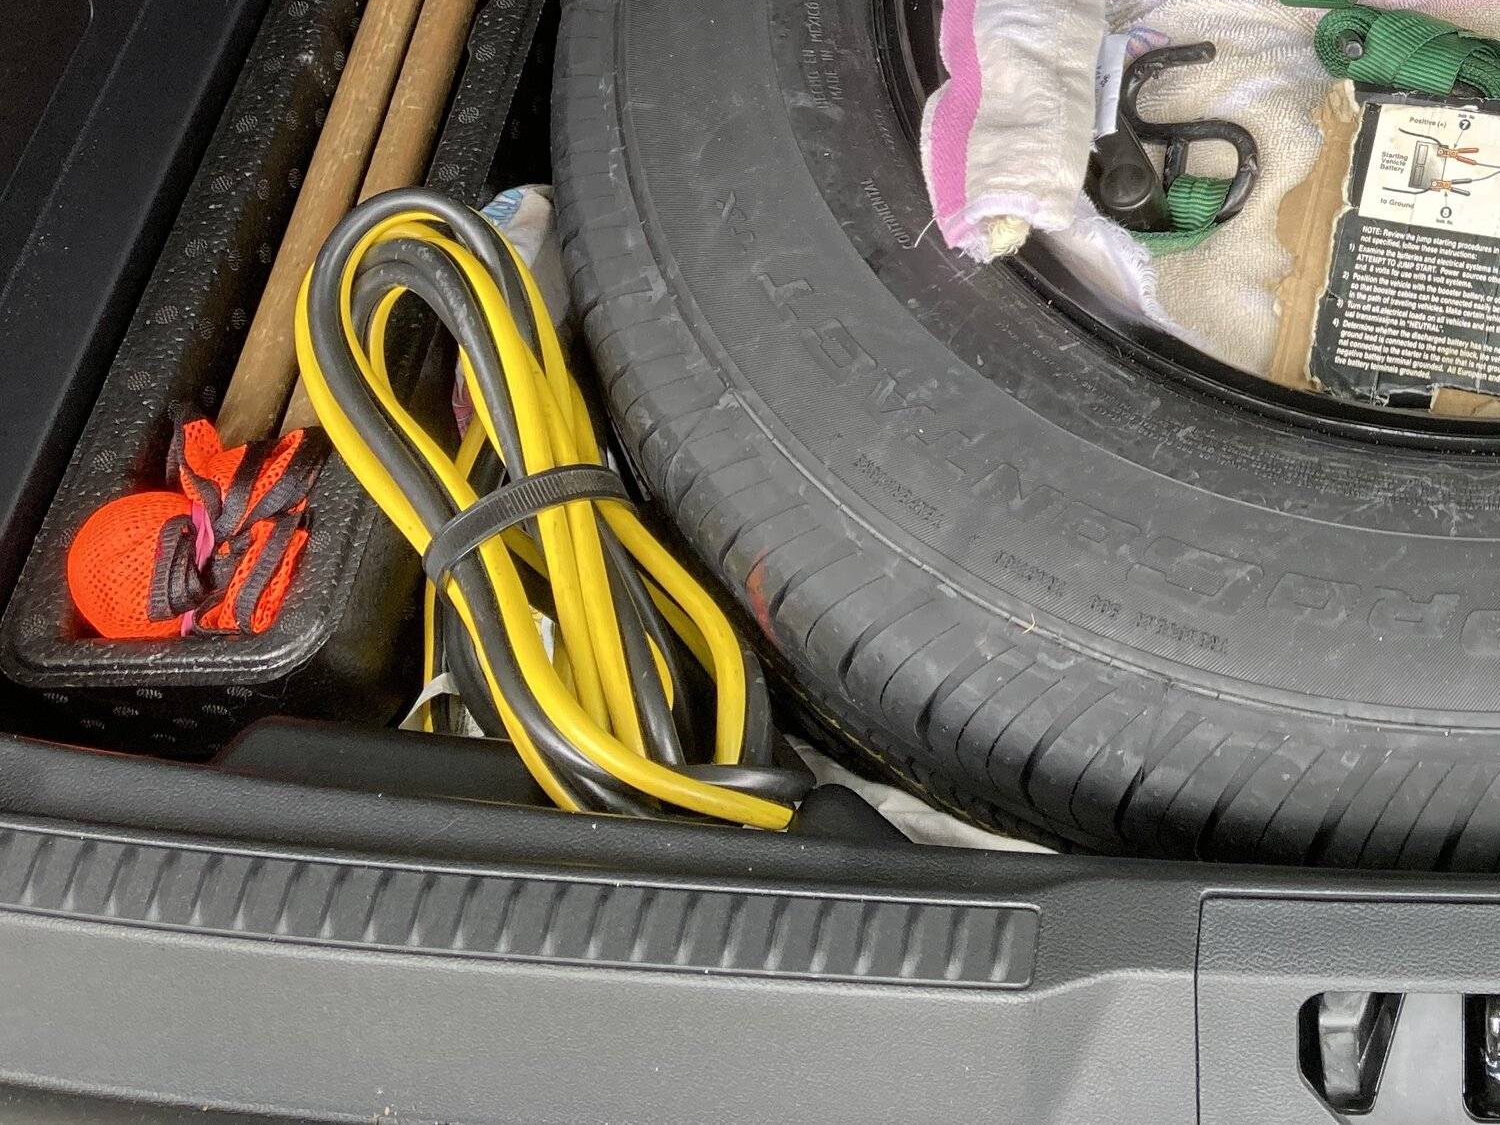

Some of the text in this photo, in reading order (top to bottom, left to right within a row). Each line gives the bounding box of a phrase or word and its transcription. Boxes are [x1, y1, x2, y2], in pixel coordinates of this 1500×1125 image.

[1409, 116, 1436, 127] Positive
[1381, 151, 1409, 162] Starting
[1381, 157, 1406, 167] Vehicle
[1380, 163, 1405, 174] Battery
[860, 174, 914, 250] CONTINENTAL
[1389, 198, 1415, 209] Ground
[1360, 234, 1371, 242] not
[1401, 241, 1420, 250] follow
[1420, 244, 1438, 253] these
[1361, 225, 1382, 235] NOTE:
[1382, 229, 1405, 239] Review
[1405, 232, 1415, 240] the
[1415, 235, 1432, 244] jump
[1432, 237, 1457, 248] starting
[1456, 240, 1492, 254] procedures
[1354, 261, 1367, 270] and
[1374, 265, 1390, 275] volts
[1390, 268, 1400, 276] for
[1412, 272, 1426, 280] with
[1432, 275, 1445, 283] volt
[1444, 277, 1473, 290] systems.
[1356, 252, 1386, 264] ATTEMPT
[1439, 266, 1459, 276] Power
[1461, 272, 1487, 281] sources
[1352, 272, 1378, 283] Position
[1378, 277, 1389, 285] the
[1389, 278, 1411, 288] vehicle
[1411, 282, 1426, 291] with
[1425, 284, 1437, 293] the
[1437, 286, 1461, 297] booster
[1355, 292, 1367, 300] the
[1366, 293, 1382, 304] path
[1416, 301, 1445, 313] vehicles.
[1444, 306, 1462, 315] Make
[1462, 309, 1485, 319] certain
[1355, 311, 1399, 325] transmissions
[1369, 362, 1398, 373] terminals
[1398, 366, 1431, 380] grounded.
